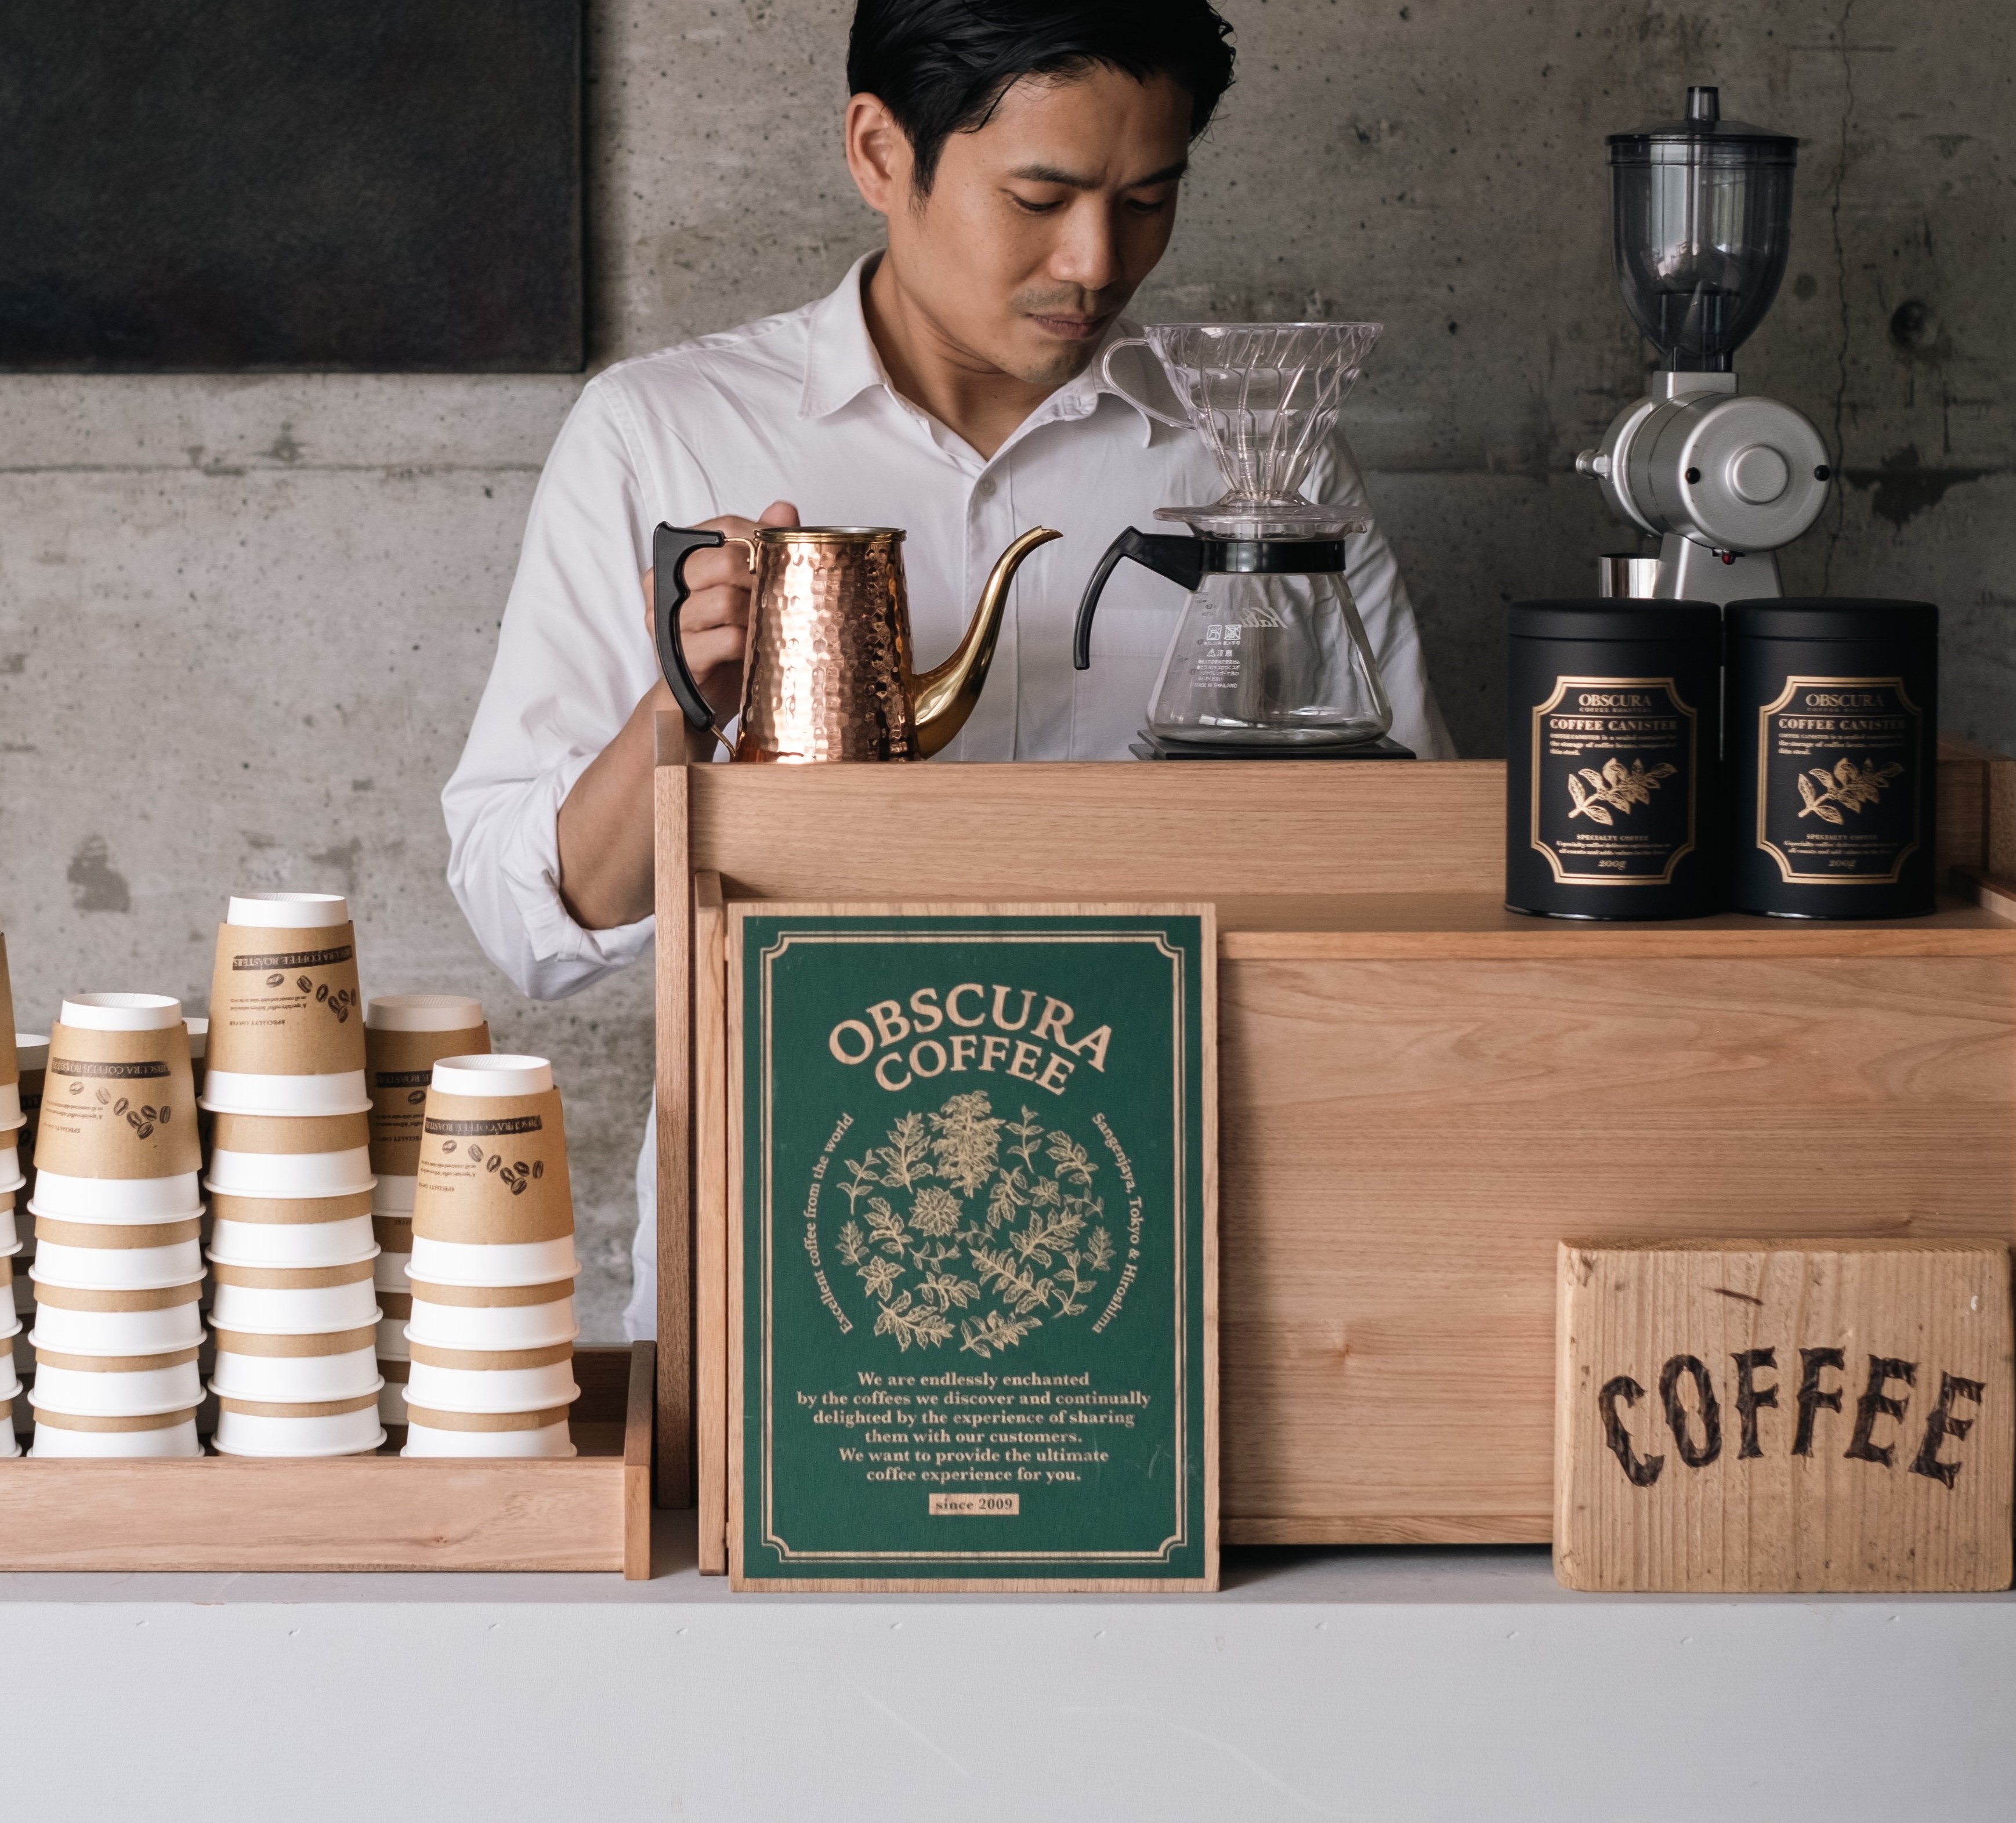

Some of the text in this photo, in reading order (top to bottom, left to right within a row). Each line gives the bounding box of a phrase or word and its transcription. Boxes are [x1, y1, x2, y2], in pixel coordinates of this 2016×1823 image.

[1578, 694, 1652, 707] OBSCURA
[1805, 694, 1884, 707] OBSCURA
[1550, 719, 1677, 730] COFFEE CANISTER
[1779, 719, 1905, 730] COFFEE CANISTER
[1598, 860, 1627, 870] 200g
[234, 957, 278, 967] ROASTERS
[281, 952, 321, 964] COFFEE
[828, 983, 1113, 1072] OBSCURA
[84, 1065, 124, 1075] COFFEE
[874, 1035, 1075, 1095] COFFEE
[803, 1112, 855, 1334] Excellent coffee from the world
[1092, 1113, 1144, 1333] Sangenjaya, Tokyo & Hiroshima
[857, 1372, 1090, 1390] We are endlessly enchanted
[797, 1391, 1151, 1409] by the coffees we discover and continually
[813, 1409, 1135, 1428] delighted by the experience of sharing
[1598, 1346, 1986, 1490] COFFEE
[865, 1429, 1083, 1443] them with our customers.
[839, 1447, 1109, 1466] We want to provide the ultimate
[866, 1466, 1081, 1485] coffee experience for you.
[936, 1498, 1013, 1510] since 2009
